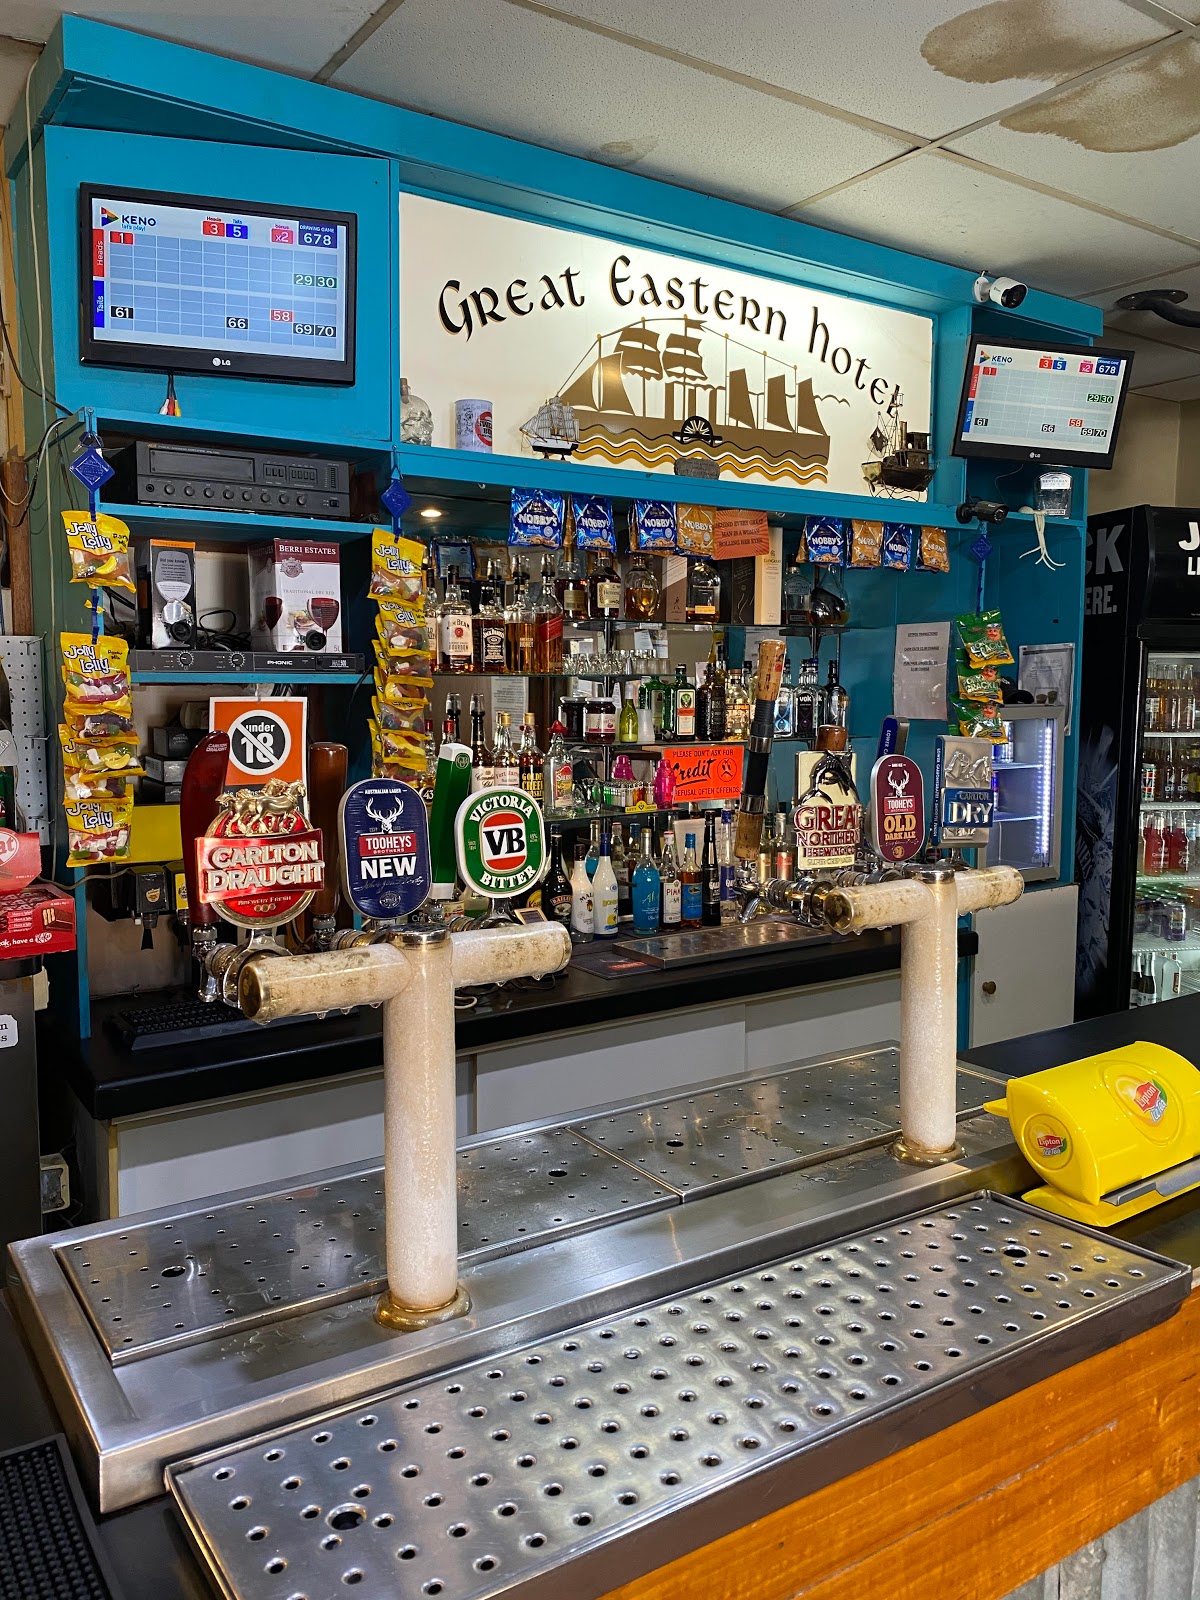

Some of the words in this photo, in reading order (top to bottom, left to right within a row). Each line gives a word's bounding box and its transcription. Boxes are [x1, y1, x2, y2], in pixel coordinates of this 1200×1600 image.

[121, 214, 157, 227] KENO
[209, 224, 218, 235] 3
[233, 226, 242, 238] 5
[117, 233, 125, 244] 1
[303, 233, 332, 246] 678
[96, 241, 104, 266] Heads
[295, 274, 313, 286] 29
[317, 277, 336, 288] 30
[96, 295, 104, 313] Tails
[438, 266, 586, 342] Great
[608, 254, 788, 341] Eastern
[115, 307, 130, 319] 61
[273, 311, 290, 322] 58
[228, 318, 246, 329] 66
[295, 324, 312, 336] 69
[317, 326, 334, 337] 70
[221, 358, 231, 366] LG
[992, 354, 1013, 364] KENO
[1043, 360, 1049, 368] 3
[1056, 361, 1063, 370] 5
[1099, 365, 1116, 375] 678
[1089, 394, 1100, 403] 29
[1101, 395, 1113, 404] 30
[977, 418, 986, 427] 61
[1042, 424, 1055, 433] 66
[1070, 419, 1082, 427] 58
[1082, 428, 1093, 436] 69
[1095, 429, 1106, 438] 70
[518, 513, 558, 527] NOBBY'S
[644, 518, 674, 528] NOBBY'S
[684, 520, 713, 532] NOBBY'S
[66, 522, 97, 536] Jolly
[82, 535, 112, 550] Lolly
[812, 536, 841, 546] NOBBY'S
[279, 545, 302, 553] BERRI
[305, 546, 336, 555] ESTATES
[375, 544, 399, 559] Jolly
[387, 558, 411, 574] Lolly
[394, 612, 416, 624] Lolly
[64, 645, 95, 659] Jolly
[80, 658, 110, 674] Lolly
[245, 722, 275, 732] under
[241, 733, 274, 764] 18
[423, 789, 434, 800] 43
[959, 792, 989, 800] CARLTON
[469, 795, 534, 823] VICTORIA
[887, 800, 913, 809] TOOHEYS
[794, 805, 862, 831] GREAT
[950, 802, 993, 824] DRY
[82, 812, 113, 829] Lolly
[884, 815, 916, 833] OLD
[483, 828, 525, 855] VB
[885, 832, 903, 840] DARK
[904, 831, 916, 839] ALE
[366, 836, 412, 850] TOOHEYS
[211, 840, 319, 869] CARLTON
[361, 856, 417, 879] NEW
[207, 862, 325, 893] DRAUGHT
[480, 865, 536, 889] BITTER
[238, 898, 267, 906] BREWERY
[1138, 1086, 1156, 1107] Lipton
[1039, 1138, 1061, 1147] Lipton
